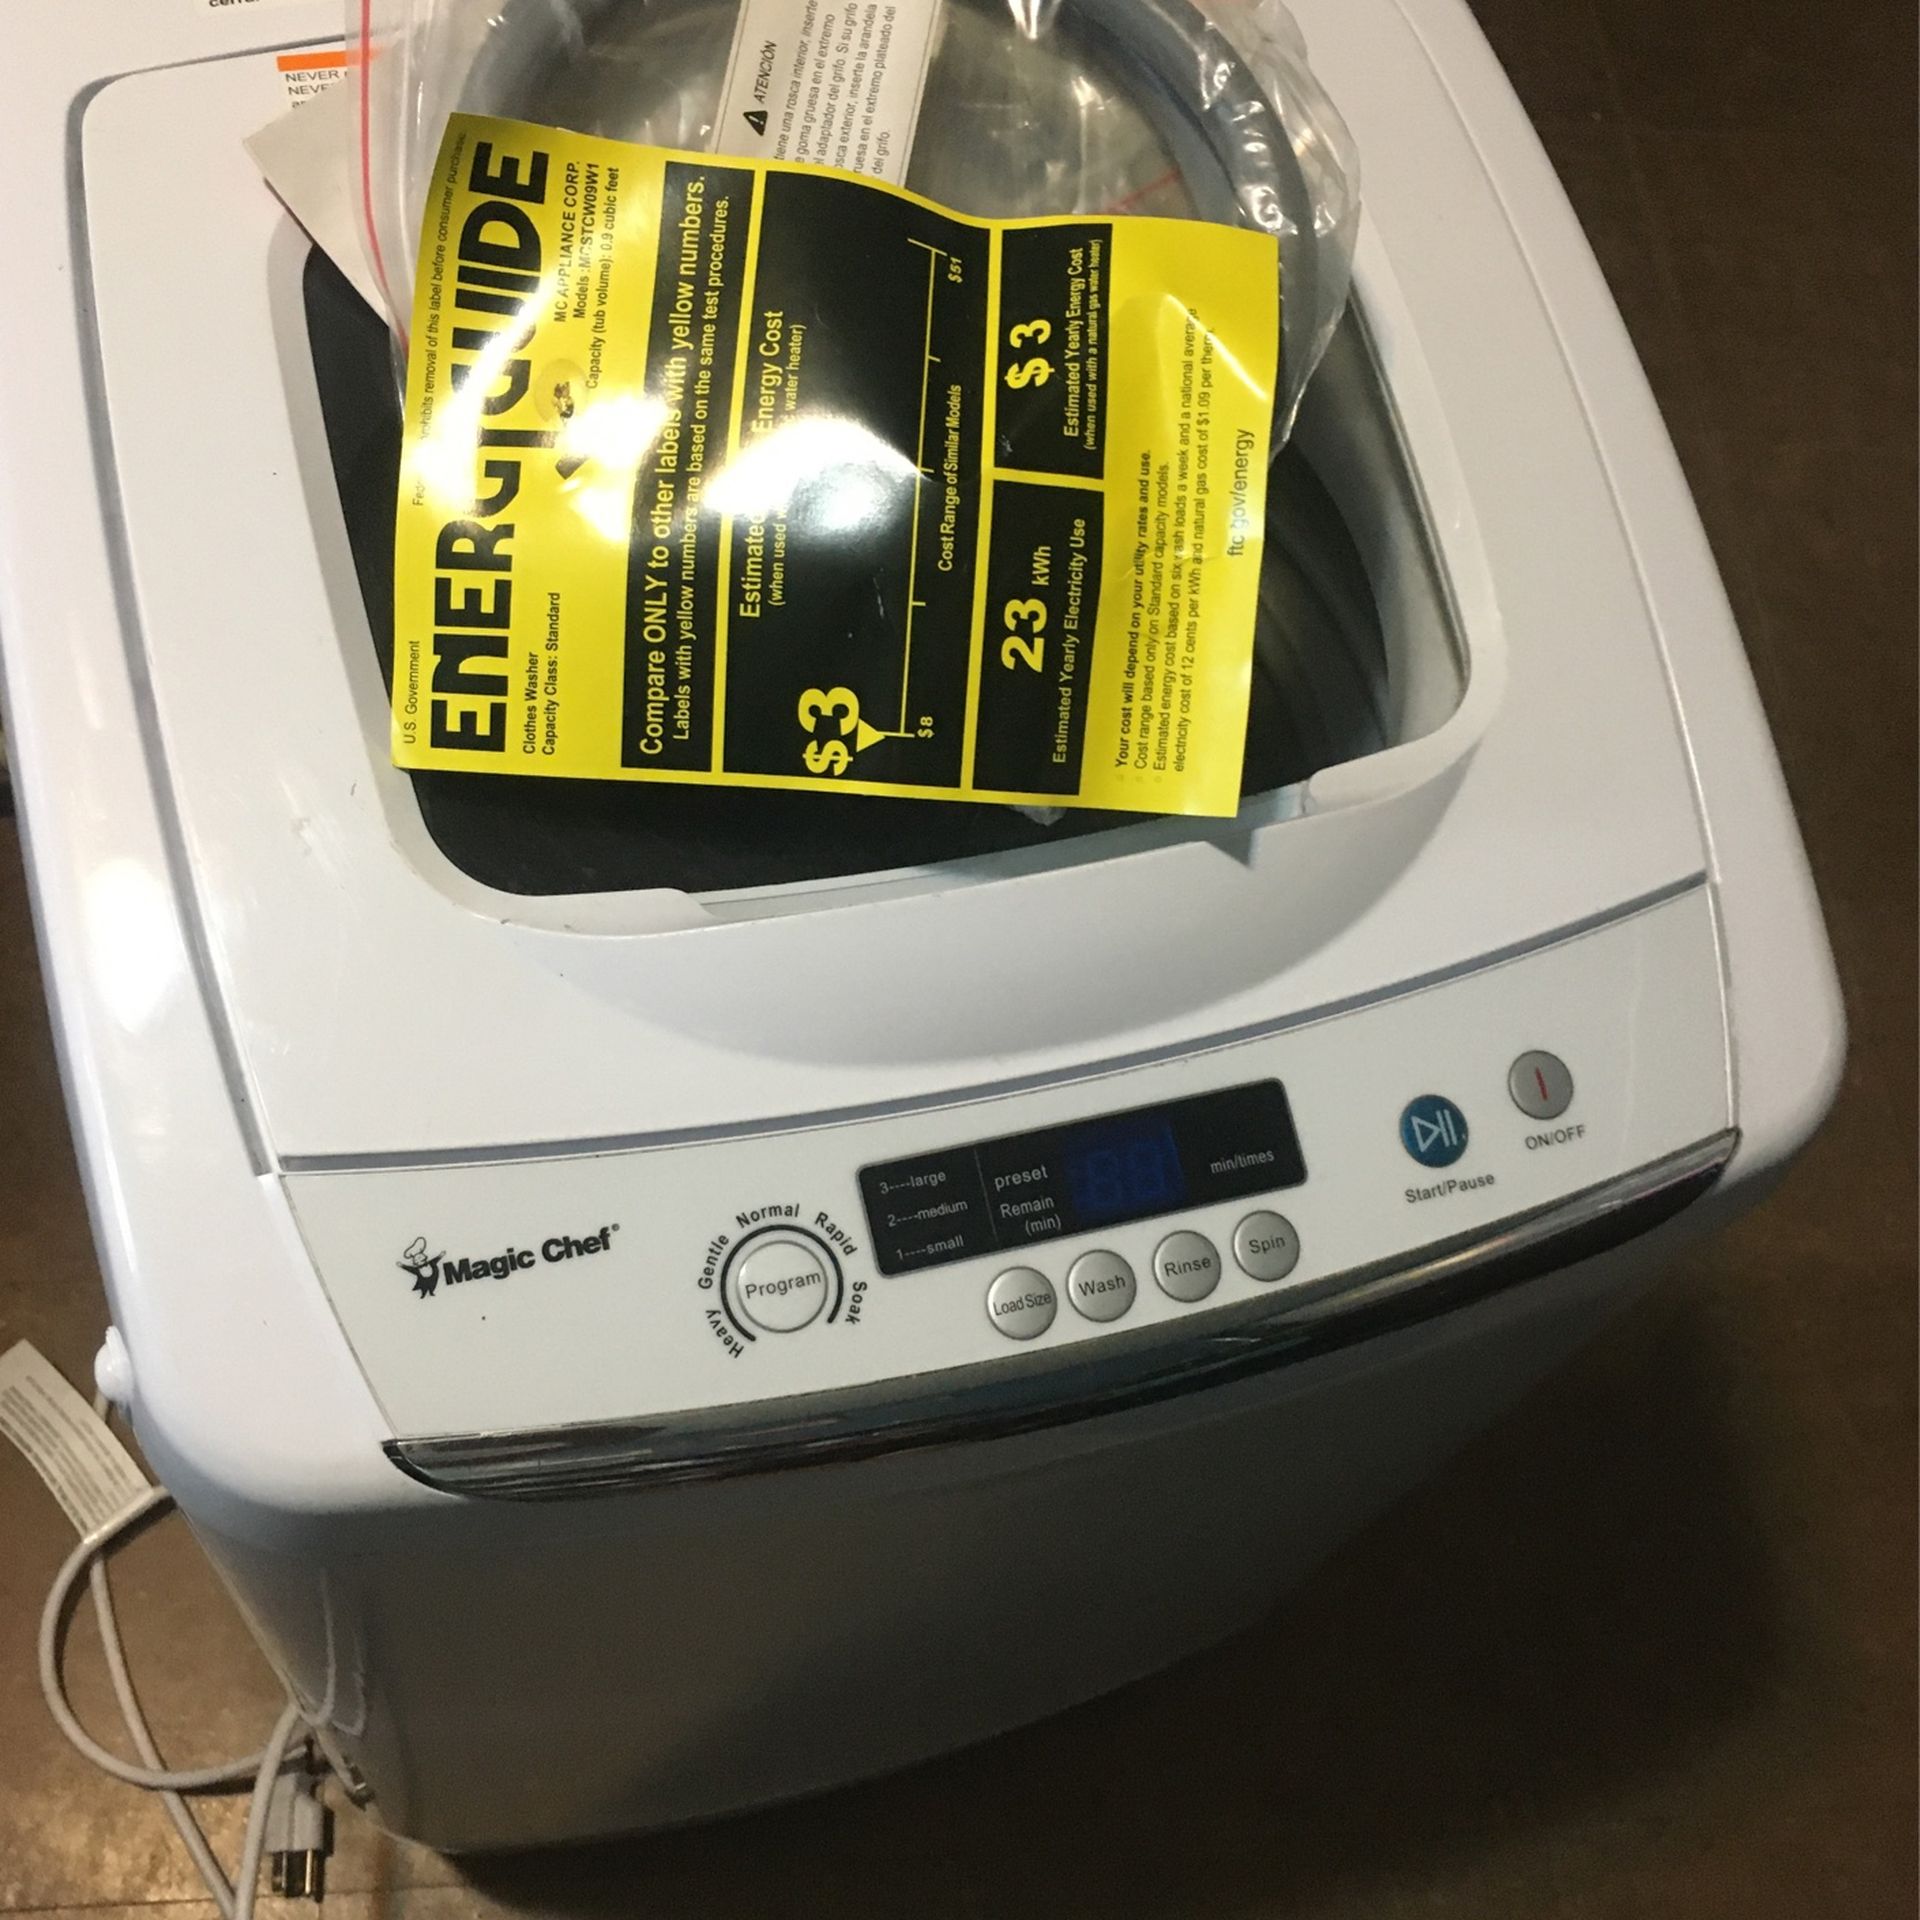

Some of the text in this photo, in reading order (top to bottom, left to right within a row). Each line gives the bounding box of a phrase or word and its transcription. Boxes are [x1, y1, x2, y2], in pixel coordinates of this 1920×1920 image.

[816, 14, 835, 58] extremo
[849, 4, 877, 98] inserte arandela
[285, 70, 340, 83] NEVER
[288, 83, 334, 95] NEVE
[754, 40, 776, 104] ATENCIÓN
[863, 24, 893, 113] extremo plateado
[786, 80, 800, 110] rosca
[803, 86, 820, 123] gruesa
[796, 125, 813, 154] goma
[816, 102, 836, 156] adaptador
[437, 186, 453, 241] consumer
[554, 161, 579, 322] MC APPLIANCE CORP.
[431, 245, 446, 281] before
[586, 167, 619, 389] Capacity (tub volume): 0.9 cubic feet
[948, 256, 962, 283] $51
[428, 283, 442, 311] label
[573, 276, 589, 318] Models
[427, 314, 440, 334] this
[759, 311, 783, 356] Cost
[1064, 248, 1085, 437] Estimated Yearly Energy Cost
[786, 324, 806, 370] heater)
[424, 350, 437, 393] removal
[785, 375, 799, 410] water
[1083, 311, 1098, 450] (when used with natural
[1180, 360, 1194, 408] national
[751, 362, 782, 433] Energy
[1179, 424, 1191, 445] and
[639, 176, 705, 754] Compare ONLY to other labels with yellow numbers.
[673, 196, 729, 739] Labels with yellow numbers are based on the same test procedures.
[938, 385, 961, 571] Cost Range of Similar Models
[1177, 450, 1189, 480] week
[1173, 496, 1186, 527] loads
[772, 524, 787, 558] used
[768, 562, 786, 606] (when
[1170, 564, 1182, 580] six
[1173, 368, 1214, 772] electricity cost 12 cents per kWh and natural gas cost $1.09 per
[1001, 546, 1051, 673] 23 kWh
[1115, 450, 1150, 768] Your cost will depend on your utility rates and use.
[1169, 584, 1180, 599] on
[1134, 463, 1169, 769] Cost range based only on Standard capacity models.
[1164, 603, 1180, 638] based
[1052, 519, 1087, 763] Estimated Yearly Electricity Use
[1163, 641, 1176, 666] cost
[404, 640, 420, 744] U.S. Government
[542, 592, 560, 755] Capacity Class: Standard
[1160, 670, 1176, 709] energy
[523, 652, 538, 754] Clothes Washer
[798, 686, 860, 776] $3
[1153, 713, 1170, 771] Estimated
[1525, 1125, 1586, 1150] ON/OFF
[994, 1165, 1048, 1191] preset
[1210, 1150, 1275, 1174] min/times
[1000, 1196, 1054, 1218] Remain
[1405, 1173, 1495, 1203] Start/Pause
[736, 1203, 799, 1228] Normal
[814, 1211, 858, 1256] Rapid
[1025, 1214, 1062, 1236] (min)
[698, 1234, 729, 1289] Gentle
[1248, 1235, 1286, 1254] Spin
[443, 1247, 536, 1286] Magic
[745, 1272, 821, 1299] Program
[1079, 1275, 1126, 1297] Wash
[1164, 1256, 1212, 1277] Rinse
[845, 1281, 867, 1324] Soak
[994, 1292, 1051, 1316] Load Size
[706, 1309, 744, 1358] Heavy
